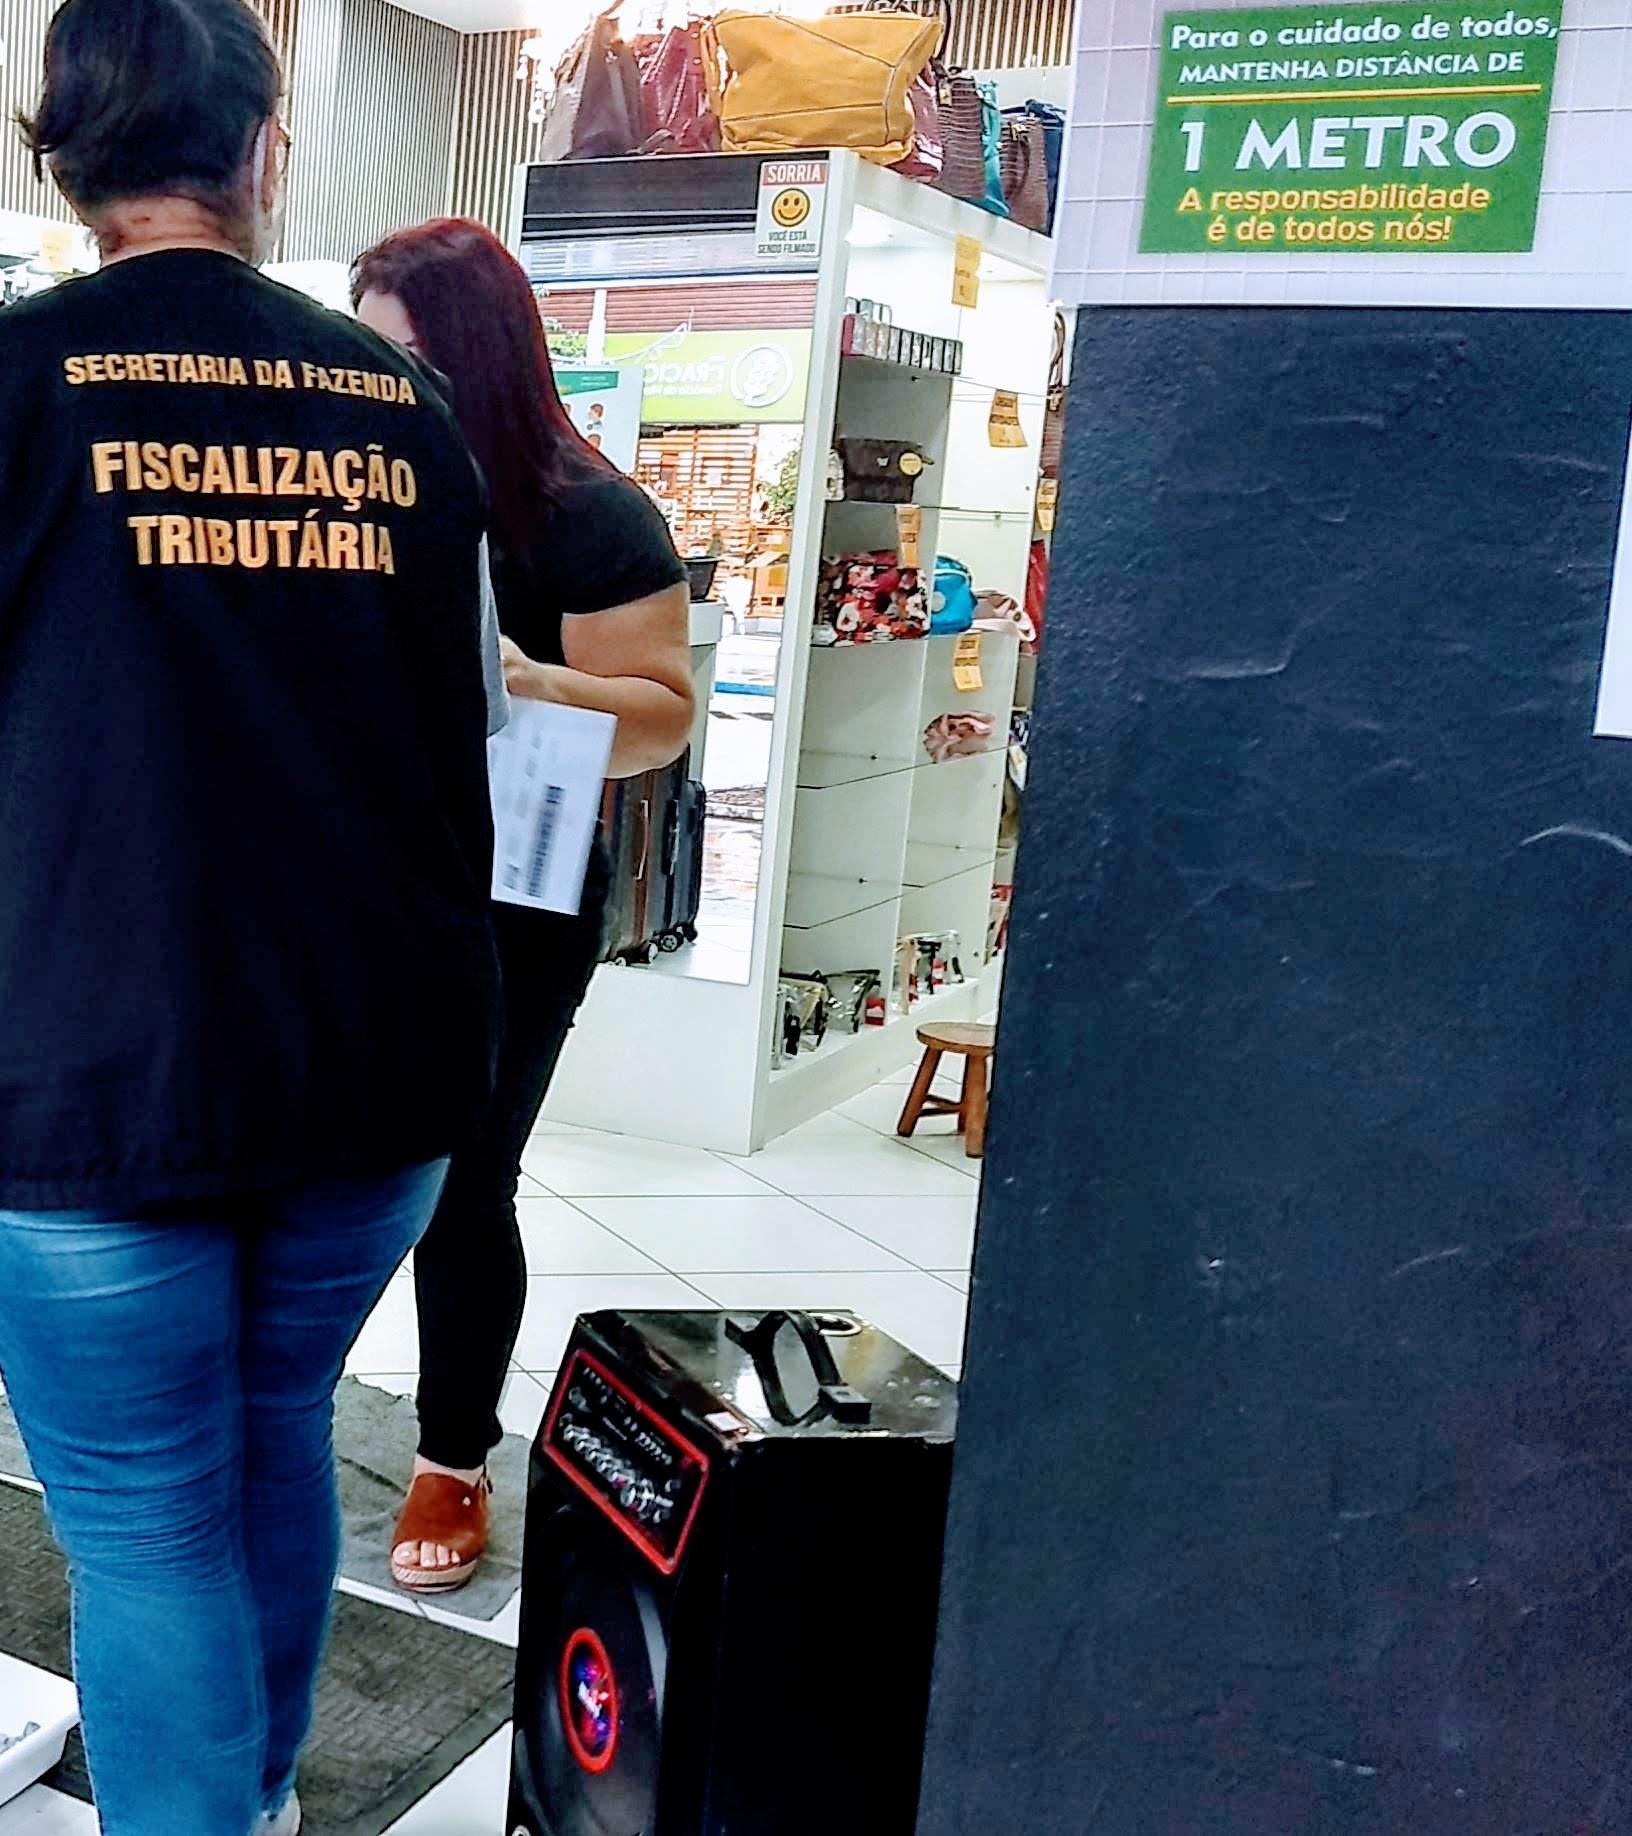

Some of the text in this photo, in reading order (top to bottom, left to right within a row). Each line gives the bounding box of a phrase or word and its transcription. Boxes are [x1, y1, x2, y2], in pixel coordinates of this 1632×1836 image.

[1170, 11, 1559, 50] Para o cuidado de todos,
[1178, 50, 1525, 84] MANTENHA DISTÂNCIA DE
[1180, 111, 1517, 172] 1 METRO
[767, 164, 821, 183] SORRIA
[1178, 183, 1491, 217] A responsabilidade
[769, 230, 787, 241] VOCÊ
[1207, 213, 1452, 242] é de todos nós!
[783, 243, 816, 254] FILMADO
[63, 353, 417, 406] SECRETARIA DA FAZENDA
[91, 441, 417, 511] FISCALIZAÇÃO
[127, 508, 395, 576] TRIBUTÁRIA
